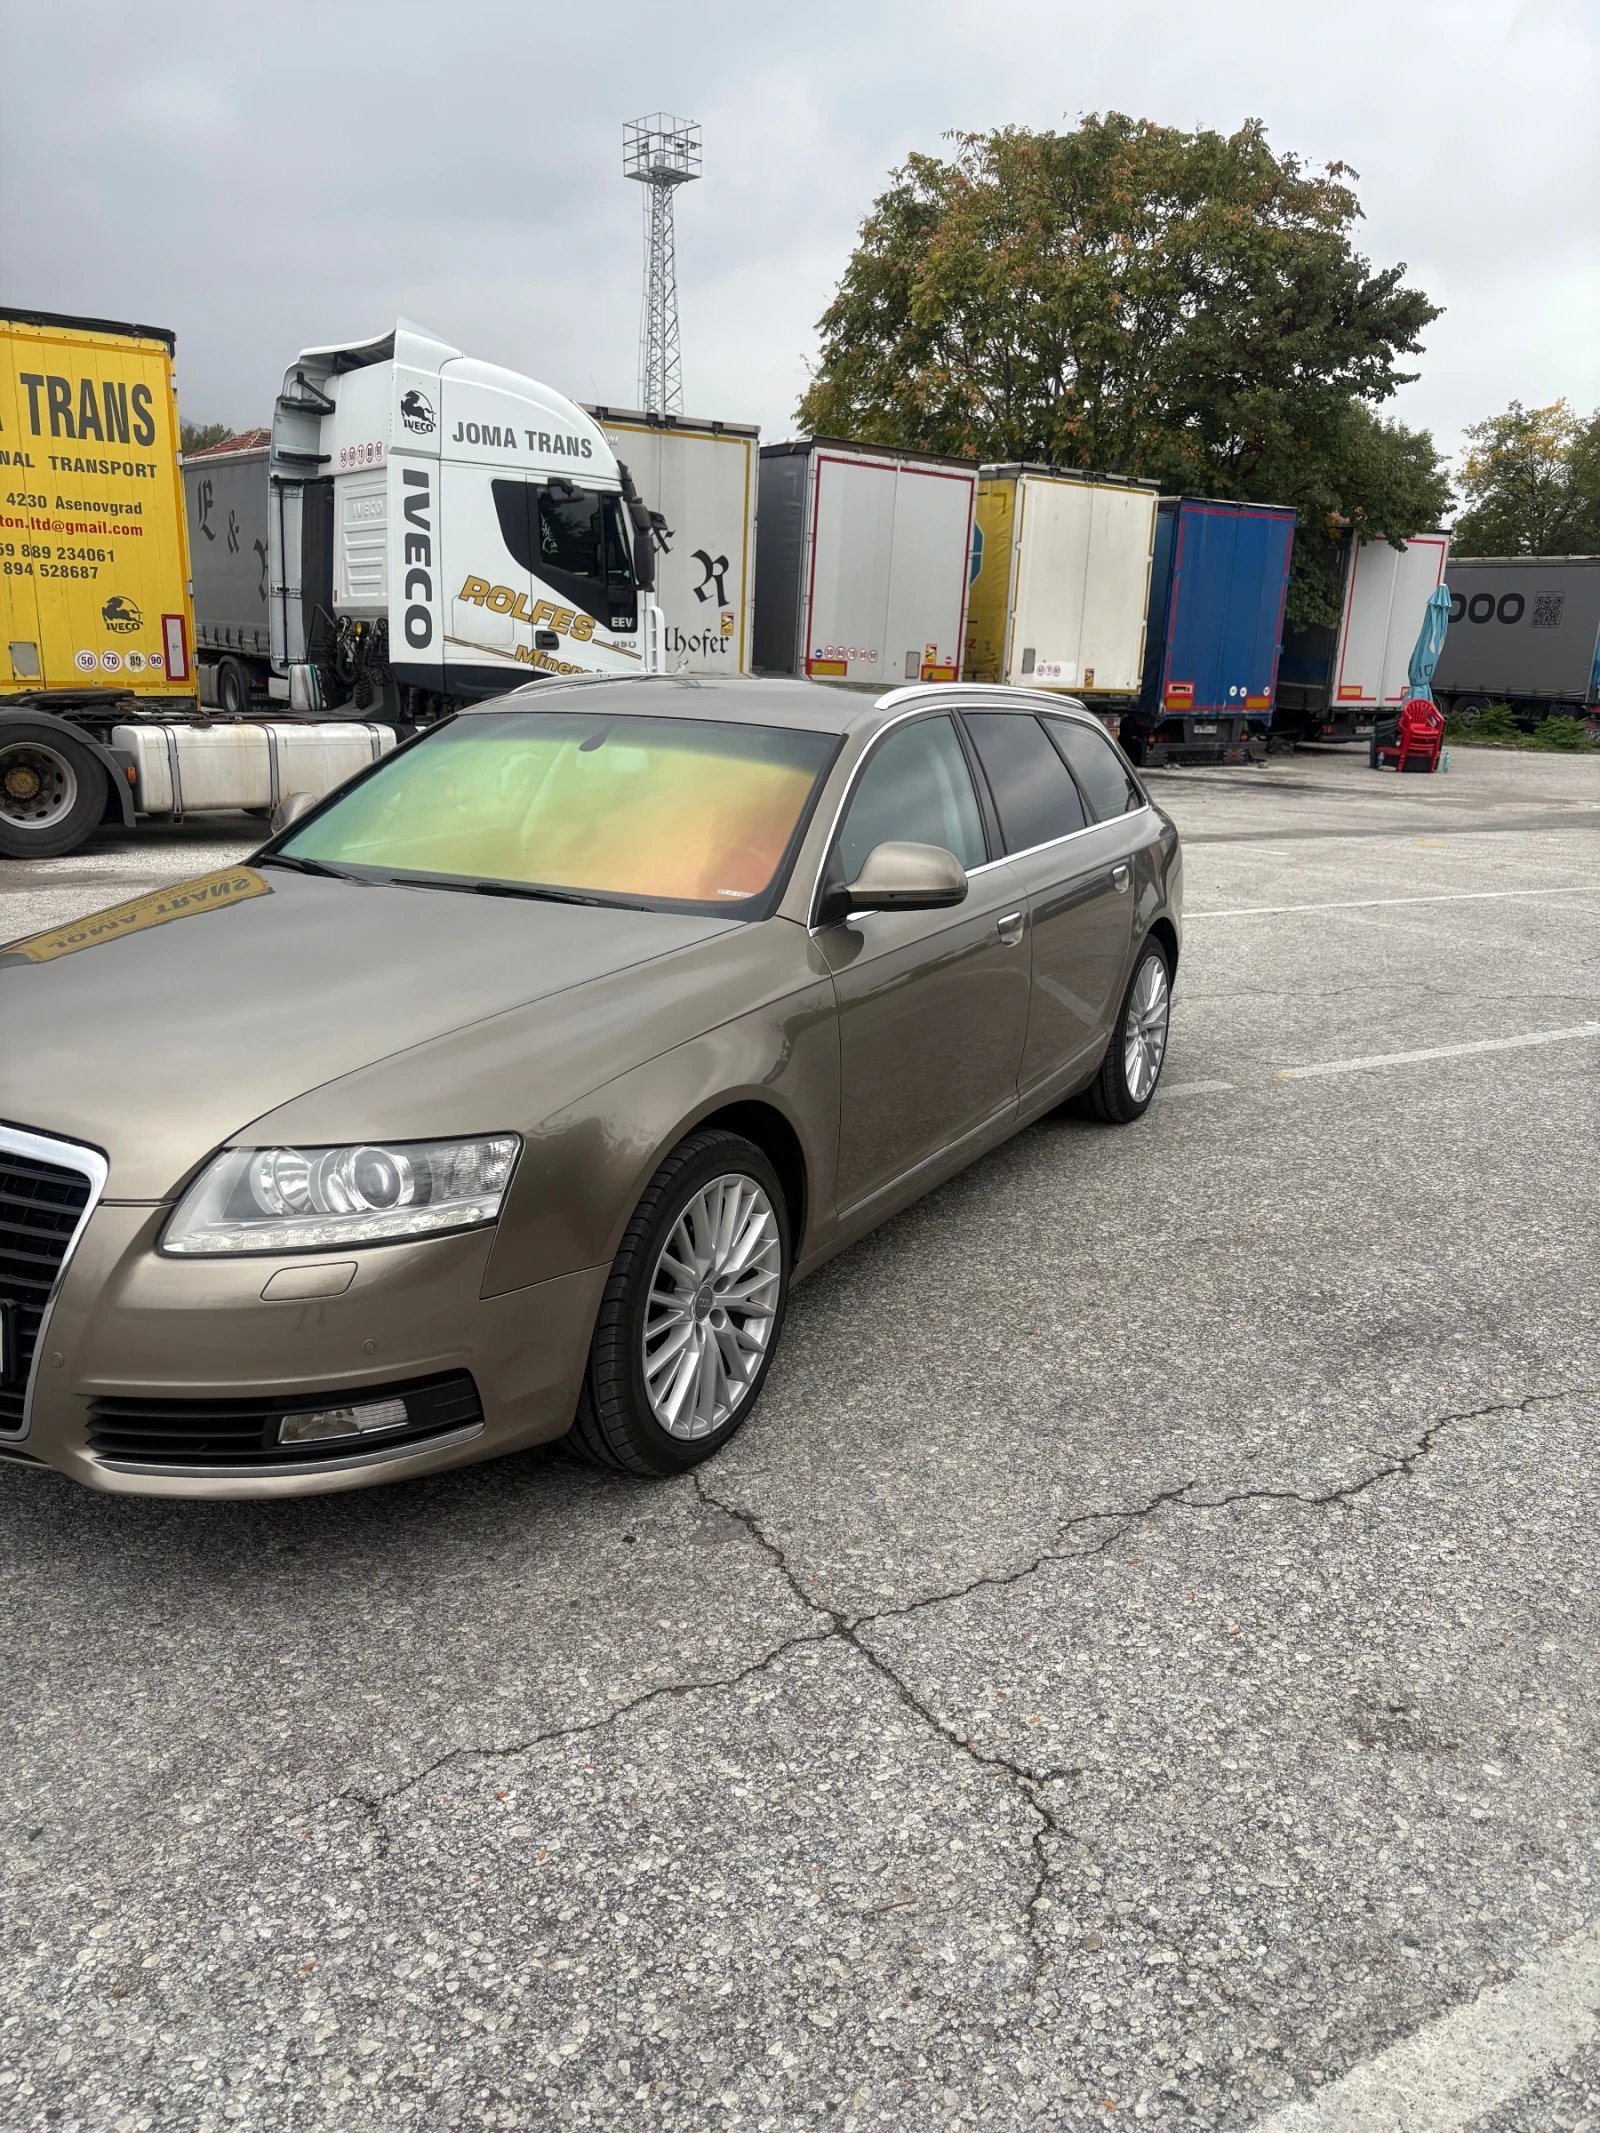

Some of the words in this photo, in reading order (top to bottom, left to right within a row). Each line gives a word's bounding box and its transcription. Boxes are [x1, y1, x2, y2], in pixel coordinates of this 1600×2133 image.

[19, 372, 156, 447] TRANS
[404, 419, 434, 432] IVECO
[452, 421, 518, 449] JOMA
[524, 430, 593, 459] TRANS
[0, 450, 35, 468] NAL
[48, 455, 157, 479] TRANSPORT
[6, 492, 47, 508] 4230
[55, 495, 143, 516] Asenovgrad
[353, 500, 382, 518] IVECO
[0, 515, 143, 536] ton.ltd@gmail.com
[21, 544, 51, 559] 889
[56, 547, 115, 562] 234061
[403, 468, 433, 650] IVECO
[3, 561, 34, 576] 894
[40, 564, 98, 579] 528687
[458, 575, 596, 641] ROLFES
[106, 622, 141, 631] IVECO
[611, 617, 633, 628] EEV
[665, 626, 730, 659] lhofer
